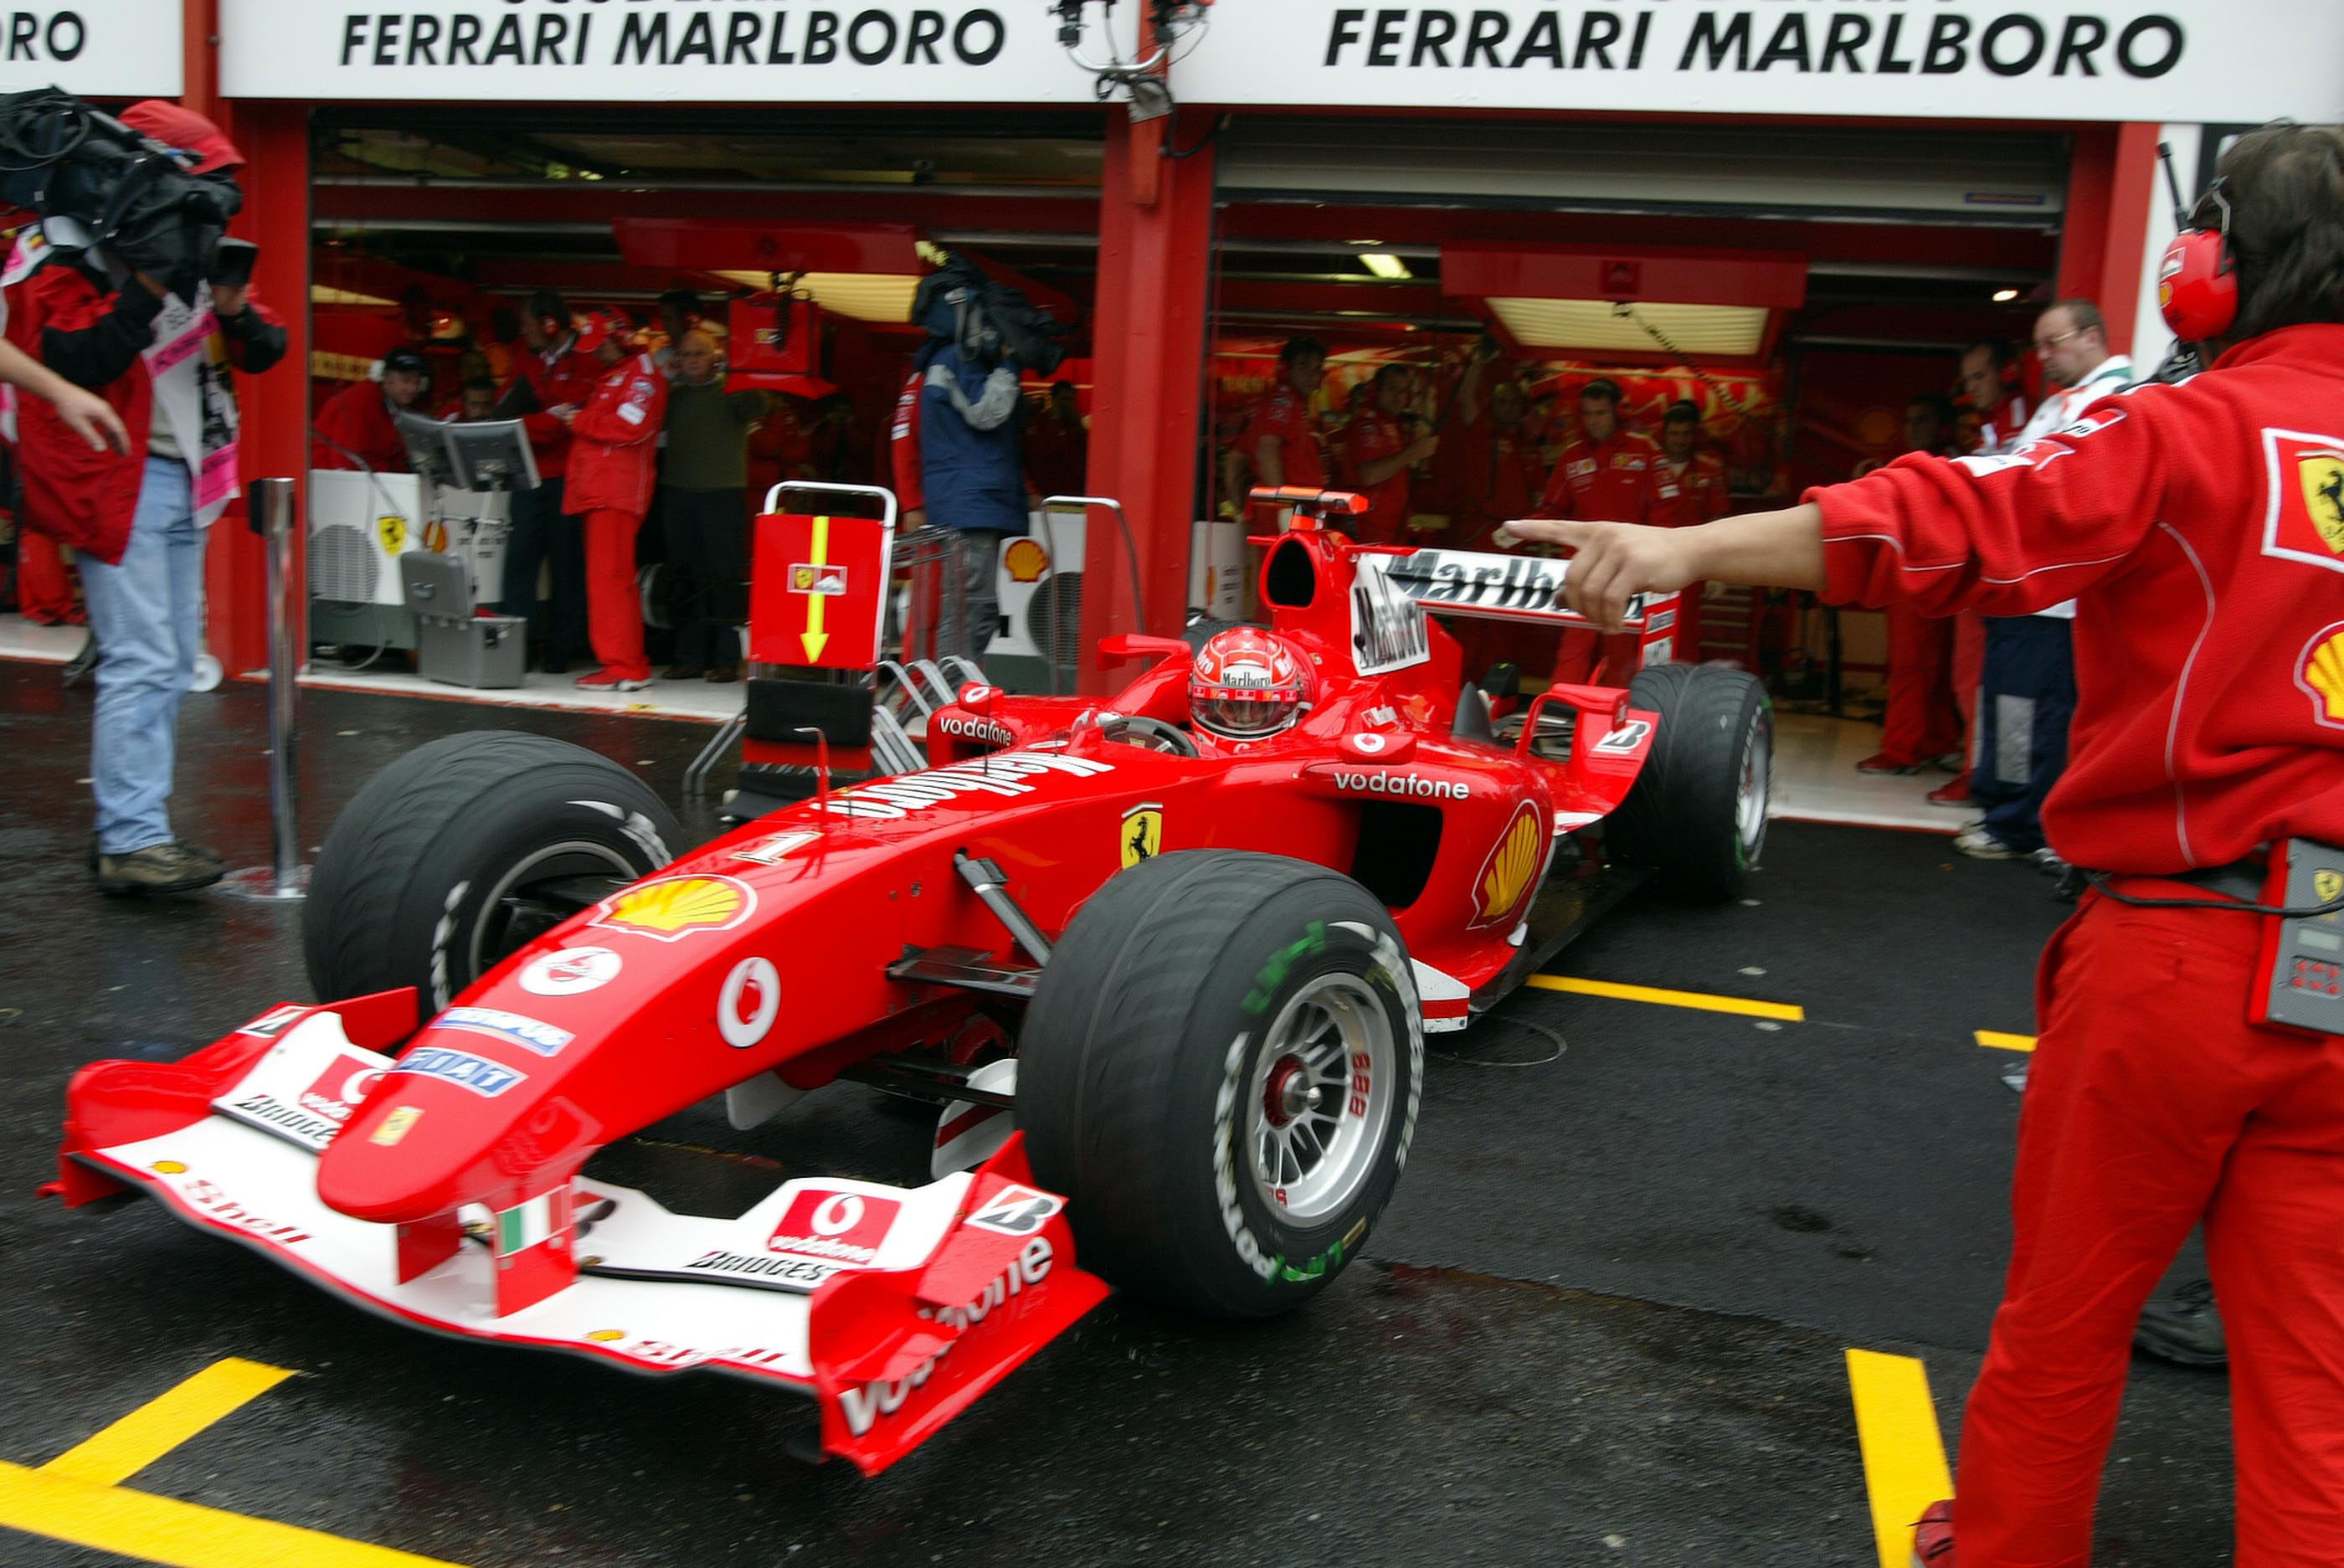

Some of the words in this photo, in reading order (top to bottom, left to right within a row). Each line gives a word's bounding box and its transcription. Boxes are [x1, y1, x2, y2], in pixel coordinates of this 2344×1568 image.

[342, 13, 591, 66] FERRARI
[614, 9, 1005, 66] MARLBORO
[1325, 10, 1653, 70] FERRARI
[1678, 12, 2185, 79] MARLBORO
[1221, 671, 1271, 687] Marlboro
[939, 716, 1012, 747] vodafone
[1334, 770, 1470, 800] vodafone
[402, 1048, 517, 1093] FIAT
